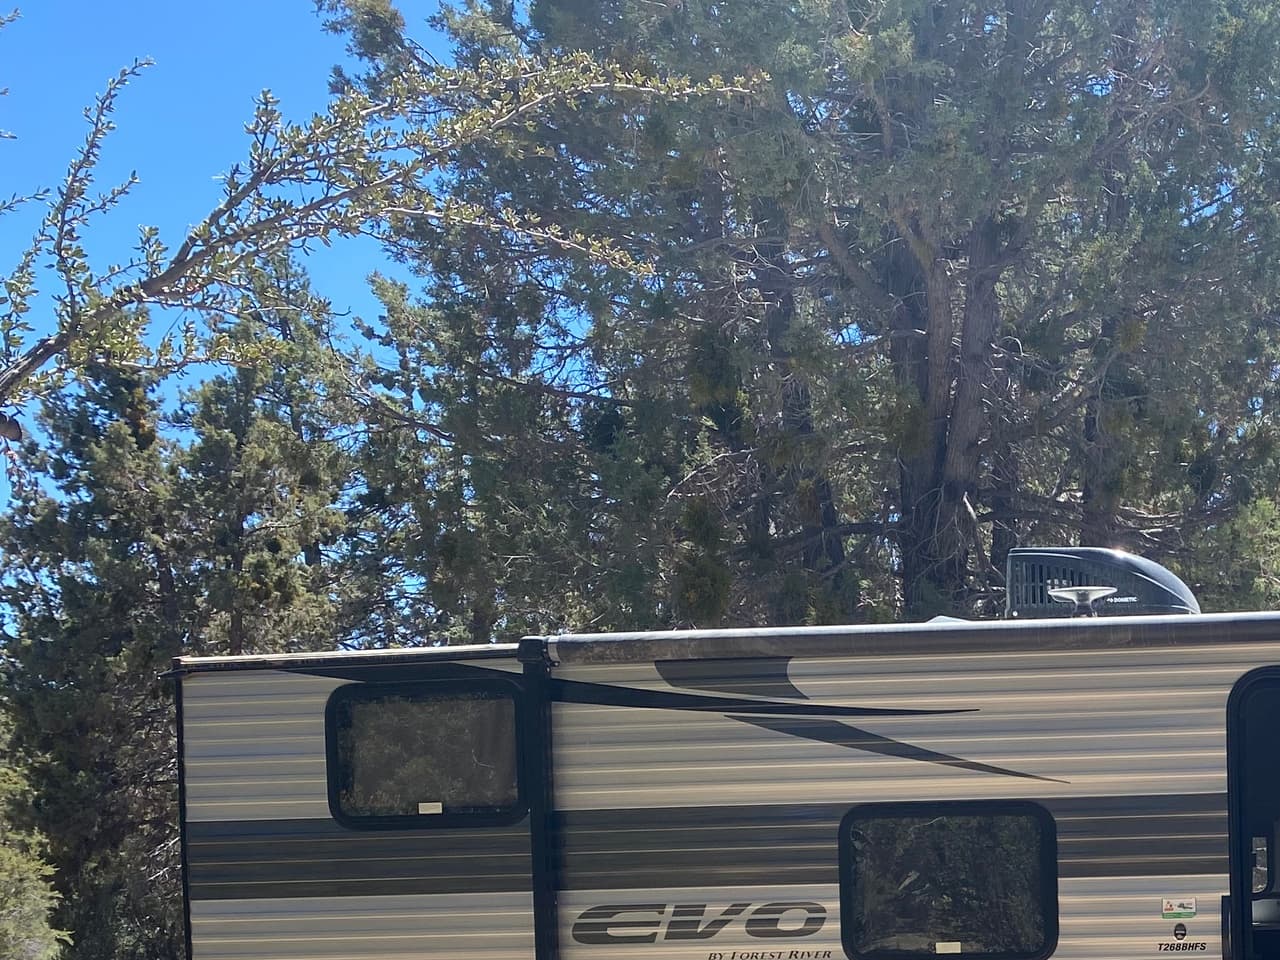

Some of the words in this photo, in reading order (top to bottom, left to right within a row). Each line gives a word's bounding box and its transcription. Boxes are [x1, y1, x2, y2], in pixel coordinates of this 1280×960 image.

[572, 902, 827, 944] EVO
[1158, 943, 1206, 951] T268BHFS
[788, 950, 832, 959] RIVER
